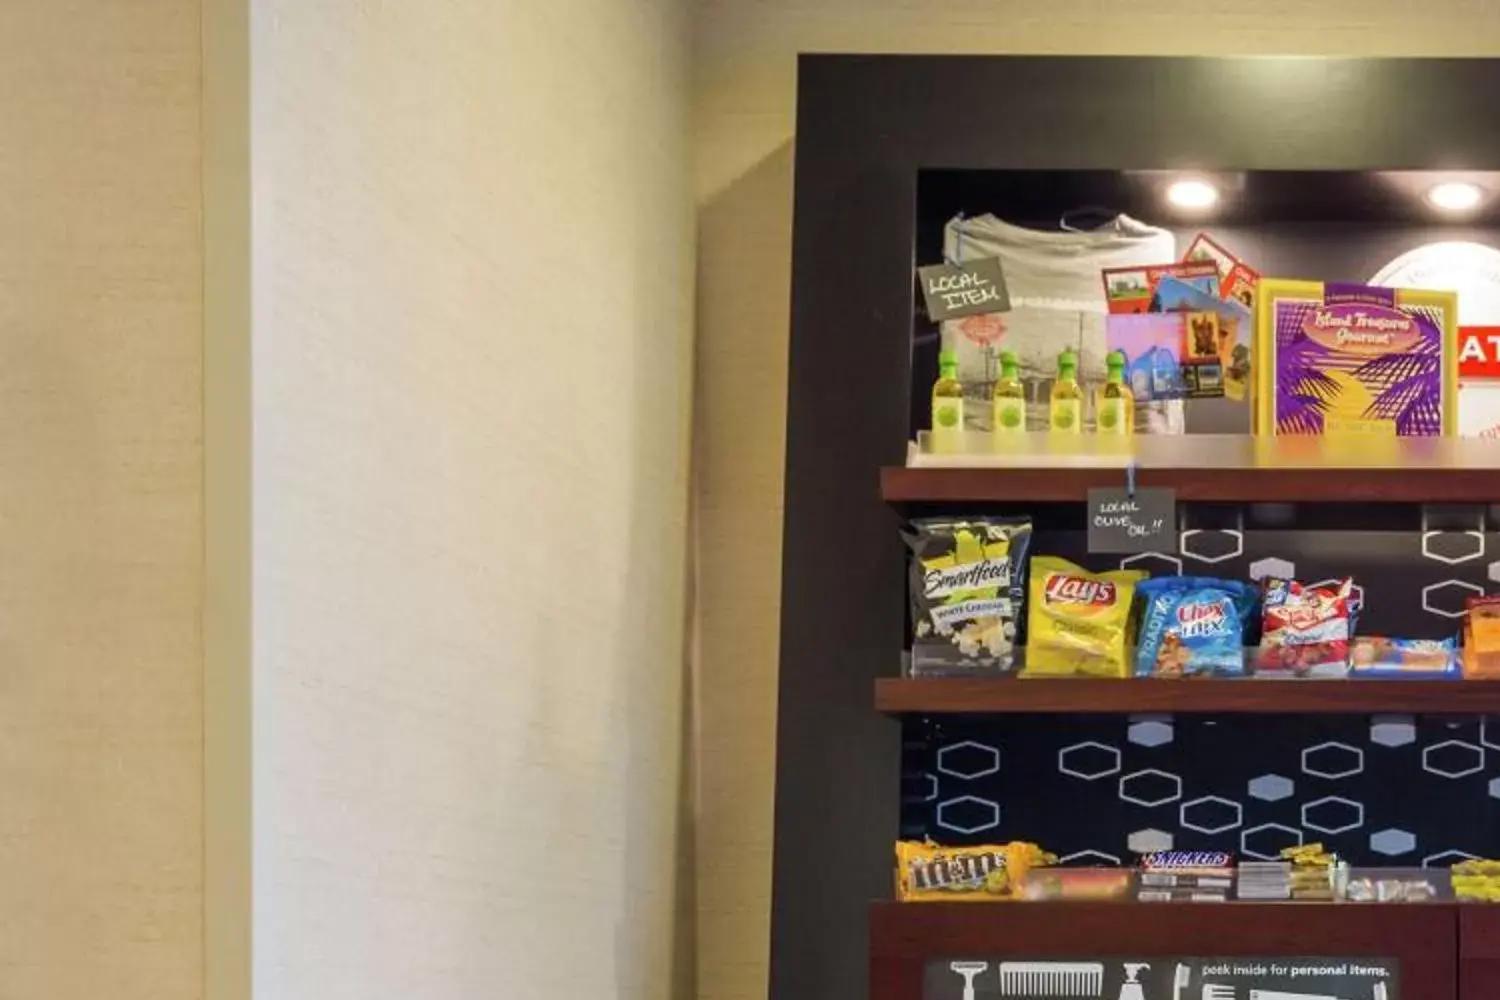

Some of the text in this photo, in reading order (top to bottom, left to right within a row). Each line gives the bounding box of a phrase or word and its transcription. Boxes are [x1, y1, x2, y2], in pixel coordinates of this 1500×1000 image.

[929, 272, 989, 294] LOCAL
[941, 286, 1001, 310] ITEM
[1100, 502, 1140, 514] LOCAL
[1094, 514, 1132, 528] OLIVE
[924, 560, 1008, 594] Smartfood
[1202, 963, 1390, 979] peek inside for personal items.
